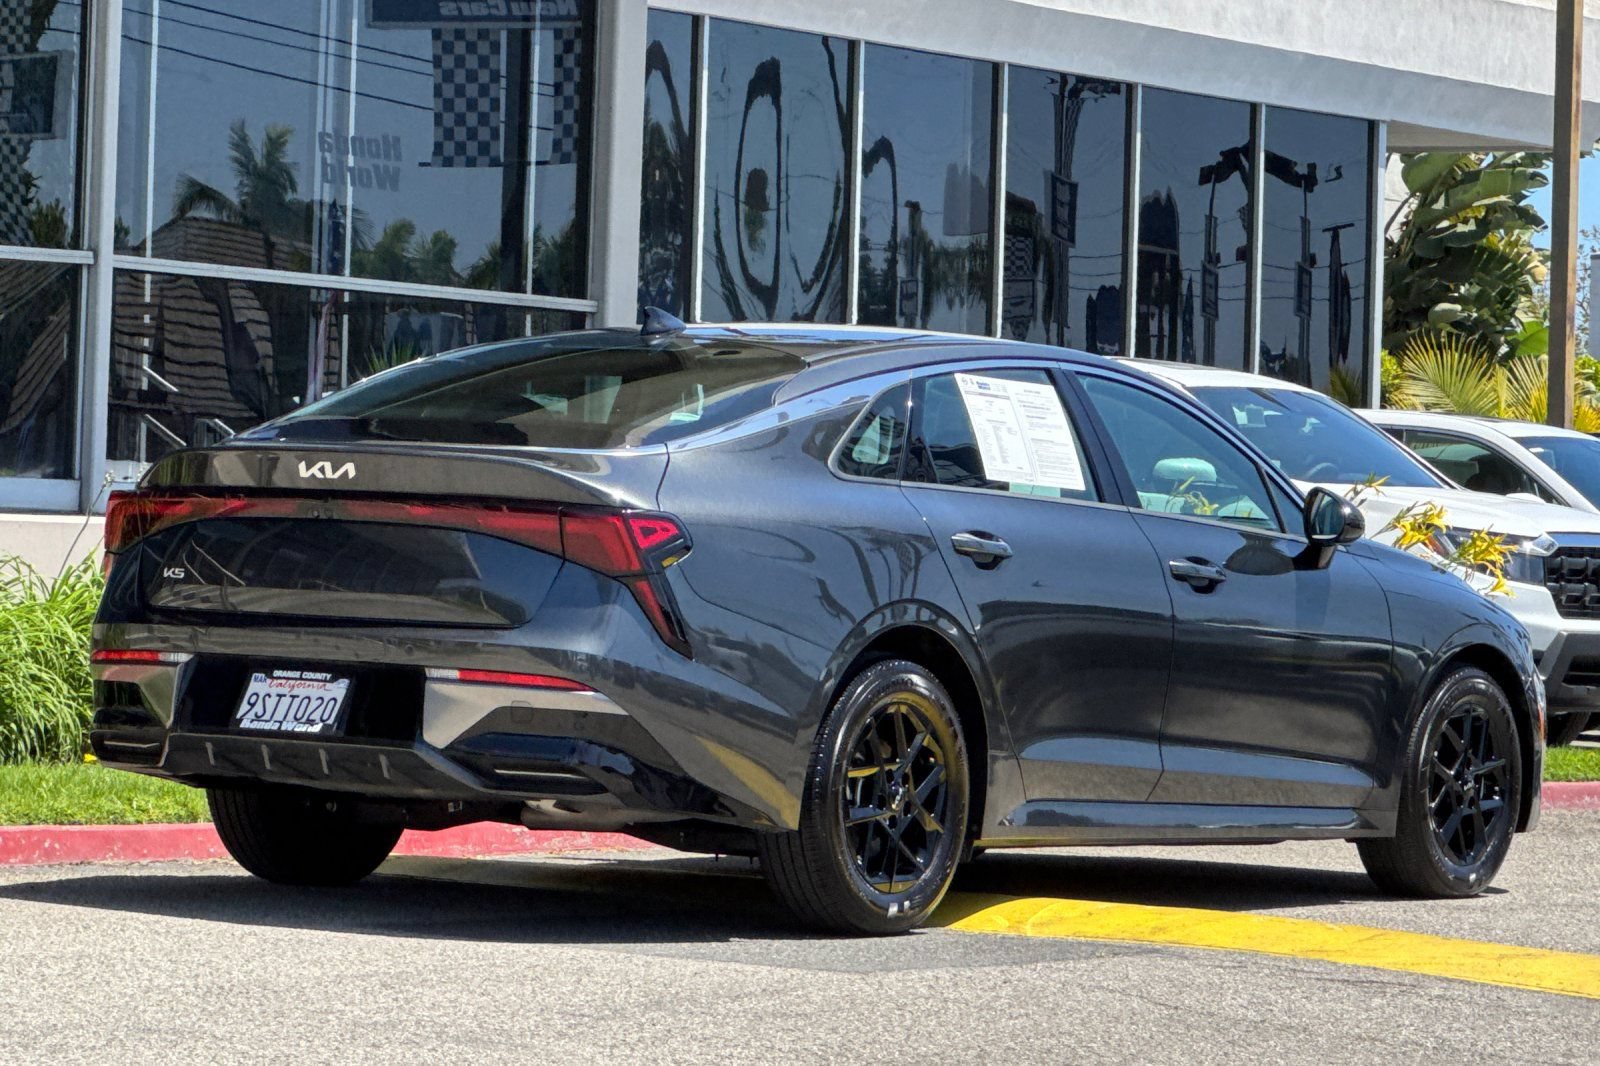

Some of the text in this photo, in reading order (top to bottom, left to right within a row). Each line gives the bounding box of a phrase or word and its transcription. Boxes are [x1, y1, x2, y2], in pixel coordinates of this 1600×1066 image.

[163, 567, 185, 579] K5
[272, 670, 332, 680] ORANGE COUNTY
[268, 678, 333, 693] California
[240, 692, 338, 723] 9STT020
